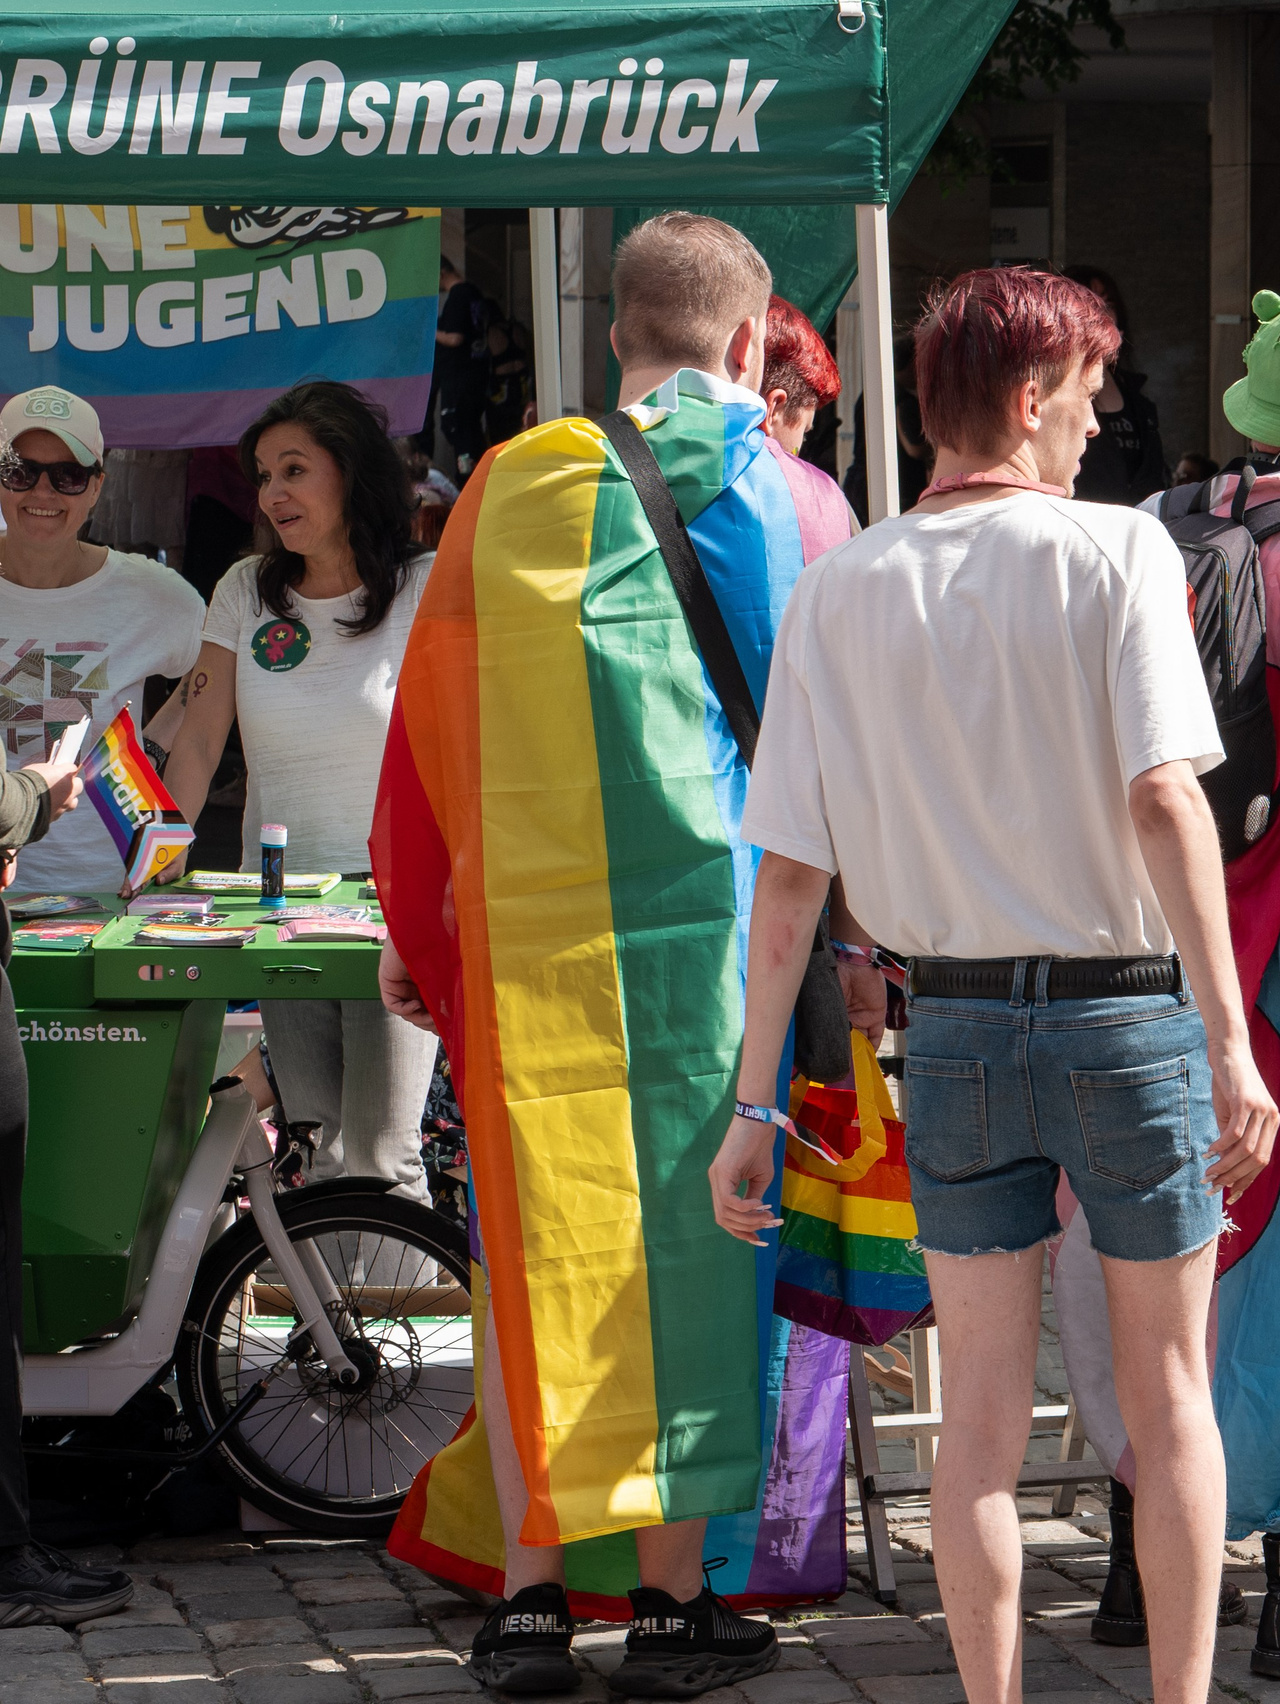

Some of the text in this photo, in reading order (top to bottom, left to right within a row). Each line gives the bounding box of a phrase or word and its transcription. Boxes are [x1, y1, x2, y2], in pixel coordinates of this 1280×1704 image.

[0, 36, 779, 156] RÜNE Osnabrück
[28, 248, 388, 353] JUGEND
[31, 398, 64, 416] 66
[18, 1021, 147, 1042] chönsten.
[744, 1105, 767, 1121] FIGHT
